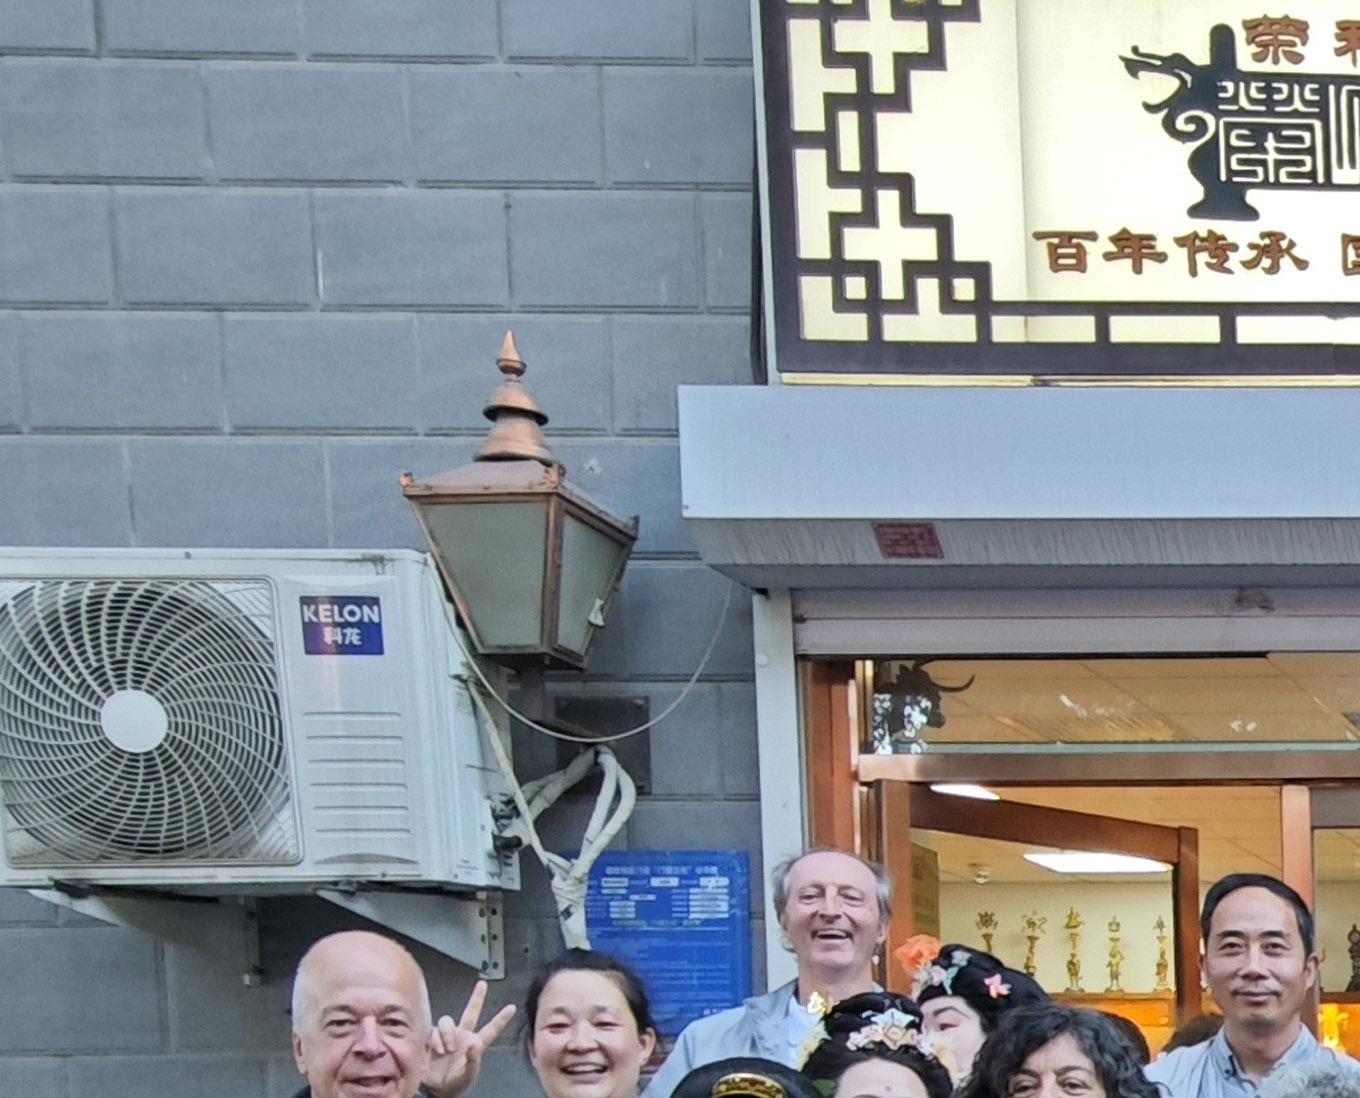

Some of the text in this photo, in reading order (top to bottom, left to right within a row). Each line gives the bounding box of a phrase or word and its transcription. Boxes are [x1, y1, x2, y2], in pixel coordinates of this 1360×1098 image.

[1032, 227, 1310, 278] 百年传承
[302, 604, 380, 623] KELON
[323, 626, 362, 646] 科龙
